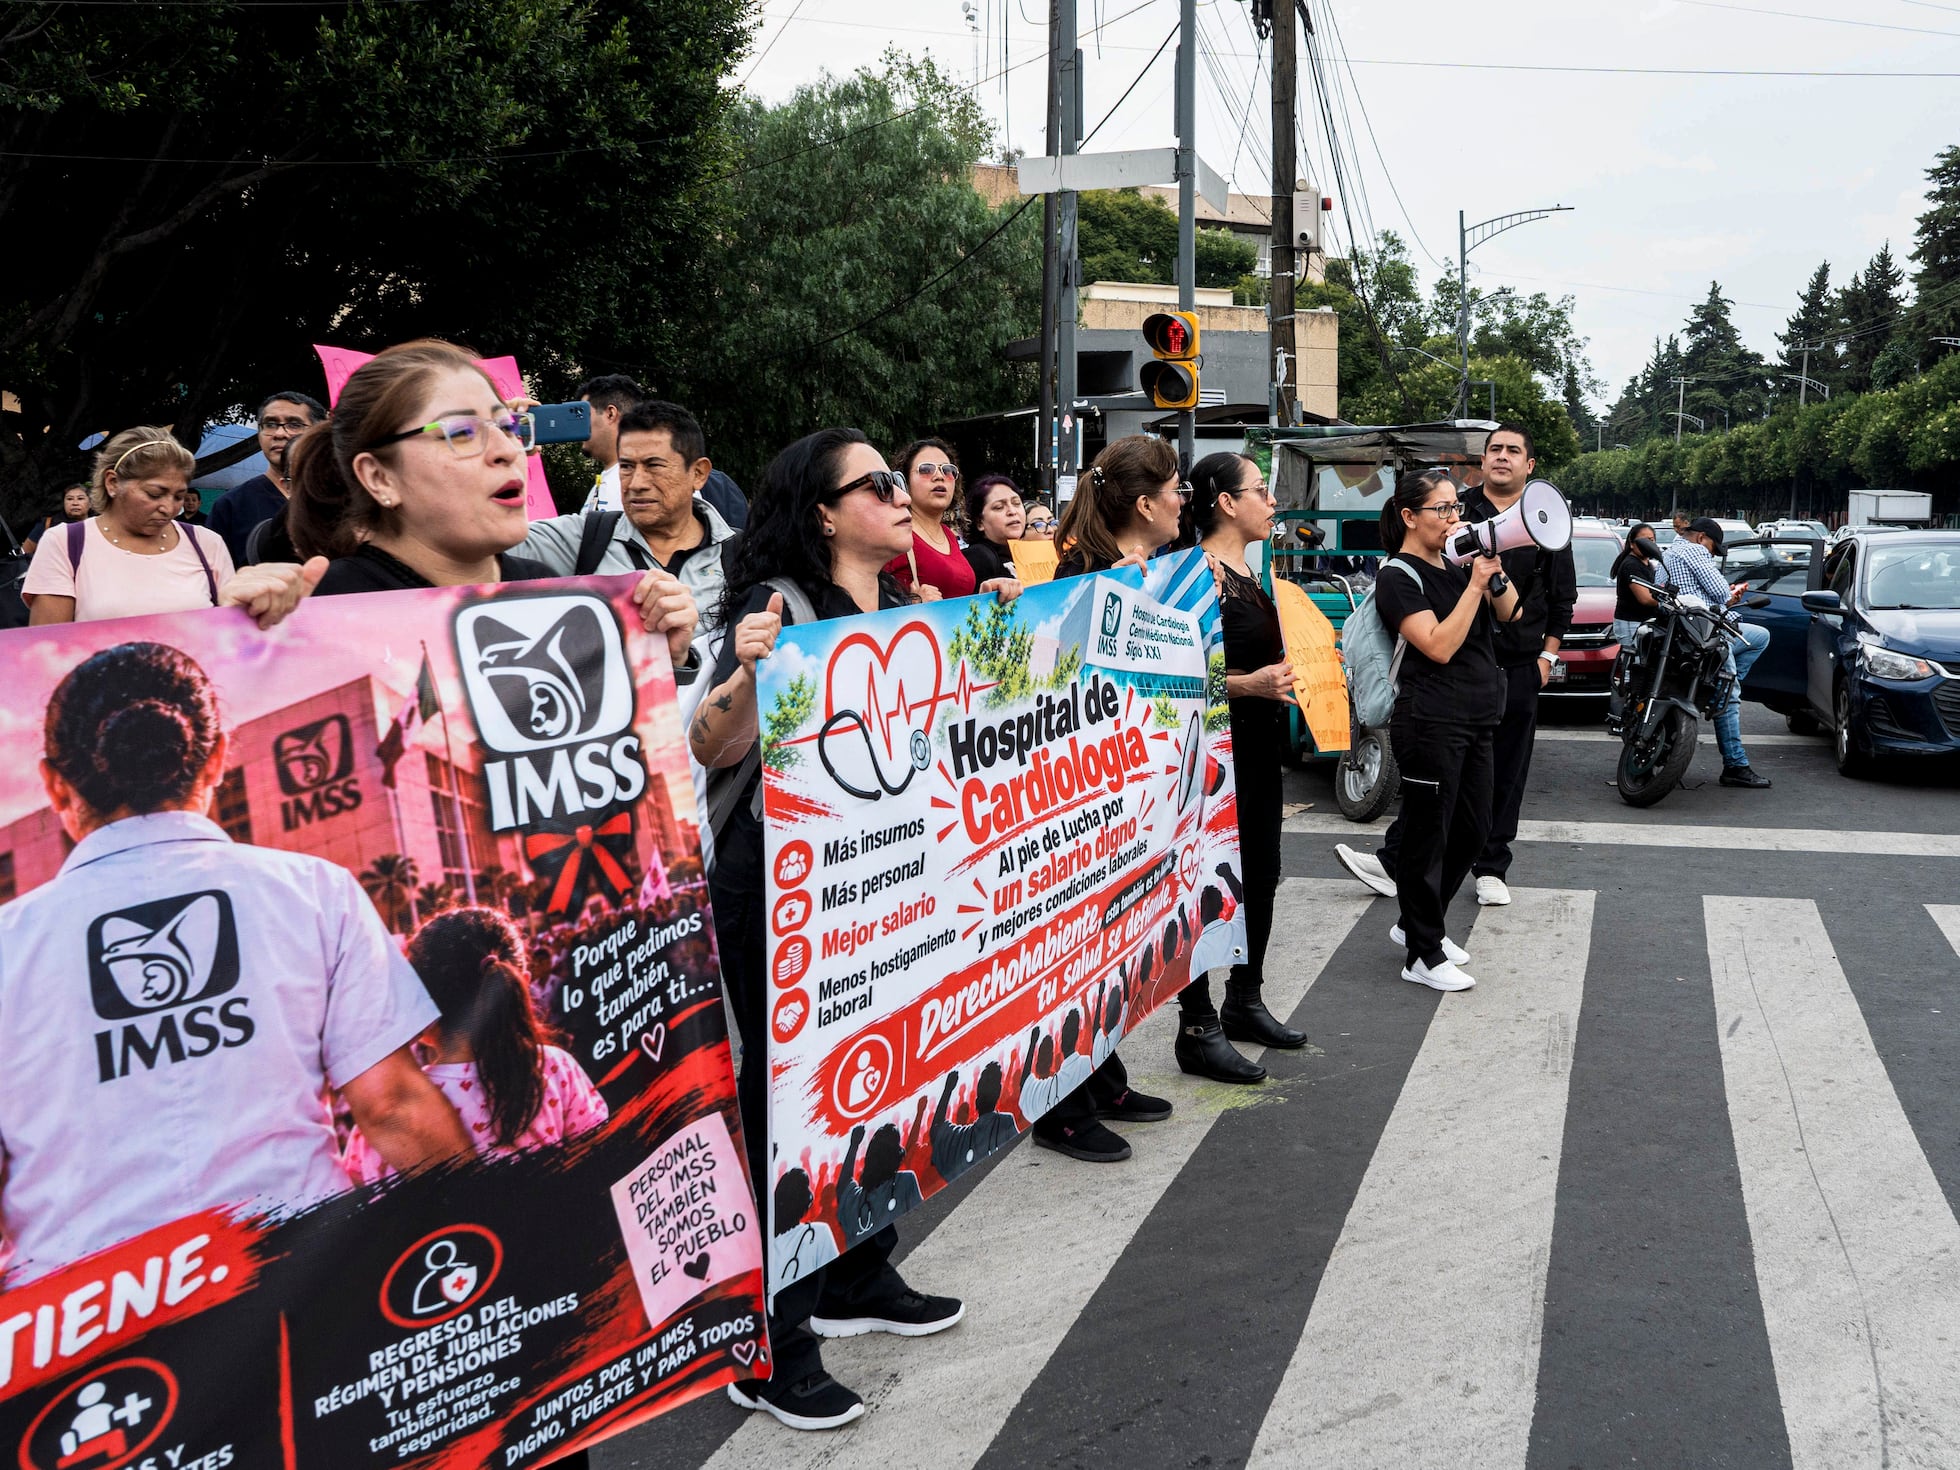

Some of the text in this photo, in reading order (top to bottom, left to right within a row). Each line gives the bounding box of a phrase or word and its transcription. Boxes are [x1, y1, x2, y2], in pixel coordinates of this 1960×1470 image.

[1097, 635, 1117, 657] IMSS
[1125, 640, 1161, 661] Siglo XXI
[1168, 632, 1194, 647] Nacional
[949, 673, 1120, 780] Hospital de
[280, 778, 363, 832] IMSS
[484, 736, 645, 831] IMSS
[961, 718, 1150, 845] Cardiología
[823, 817, 925, 867] Más insumos
[993, 816, 1137, 916] un salario digno
[998, 795, 1124, 878] Al pie de Lucha por
[821, 851, 926, 912] Más personal
[978, 929, 989, 953] y
[991, 901, 1043, 943] mejores
[1045, 865, 1107, 913] condiciones
[1109, 839, 1148, 876] laborales
[563, 912, 702, 1012] lo que pedimos
[572, 920, 637, 977] Porque
[821, 892, 936, 960] Mejor salario
[596, 961, 669, 1026] también
[818, 927, 956, 1003] Menos hostigamiento
[1037, 978, 1056, 1013] tu
[1061, 930, 1103, 995] salud
[1107, 925, 1122, 958] se
[94, 997, 255, 1083] IMSS
[592, 974, 713, 1060] es para ti...
[818, 986, 873, 1029] laboral
[628, 1133, 710, 1203] PERSONAL
[636, 1152, 717, 1224] DEL IMSS
[644, 1176, 717, 1240] TAMBIÉN
[658, 1202, 716, 1254] SOMOS
[651, 1213, 746, 1286] EL PUEBLO
[314, 1293, 579, 1418] RÉGIMEN DE JUBILACIONES
[369, 1295, 522, 1372] REGRESO DEL
[378, 1334, 522, 1409] Y PENSIONES
[386, 1372, 495, 1429] Tu esfuerzo
[505, 1315, 755, 1468] DIGNO, FUERTE Y PARA TODOS
[530, 1317, 695, 1428] JUNTOS POR UN IMSS
[369, 1376, 521, 1453] también merece
[397, 1402, 495, 1458] seguridad.
[164, 1443, 185, 1468] Y
